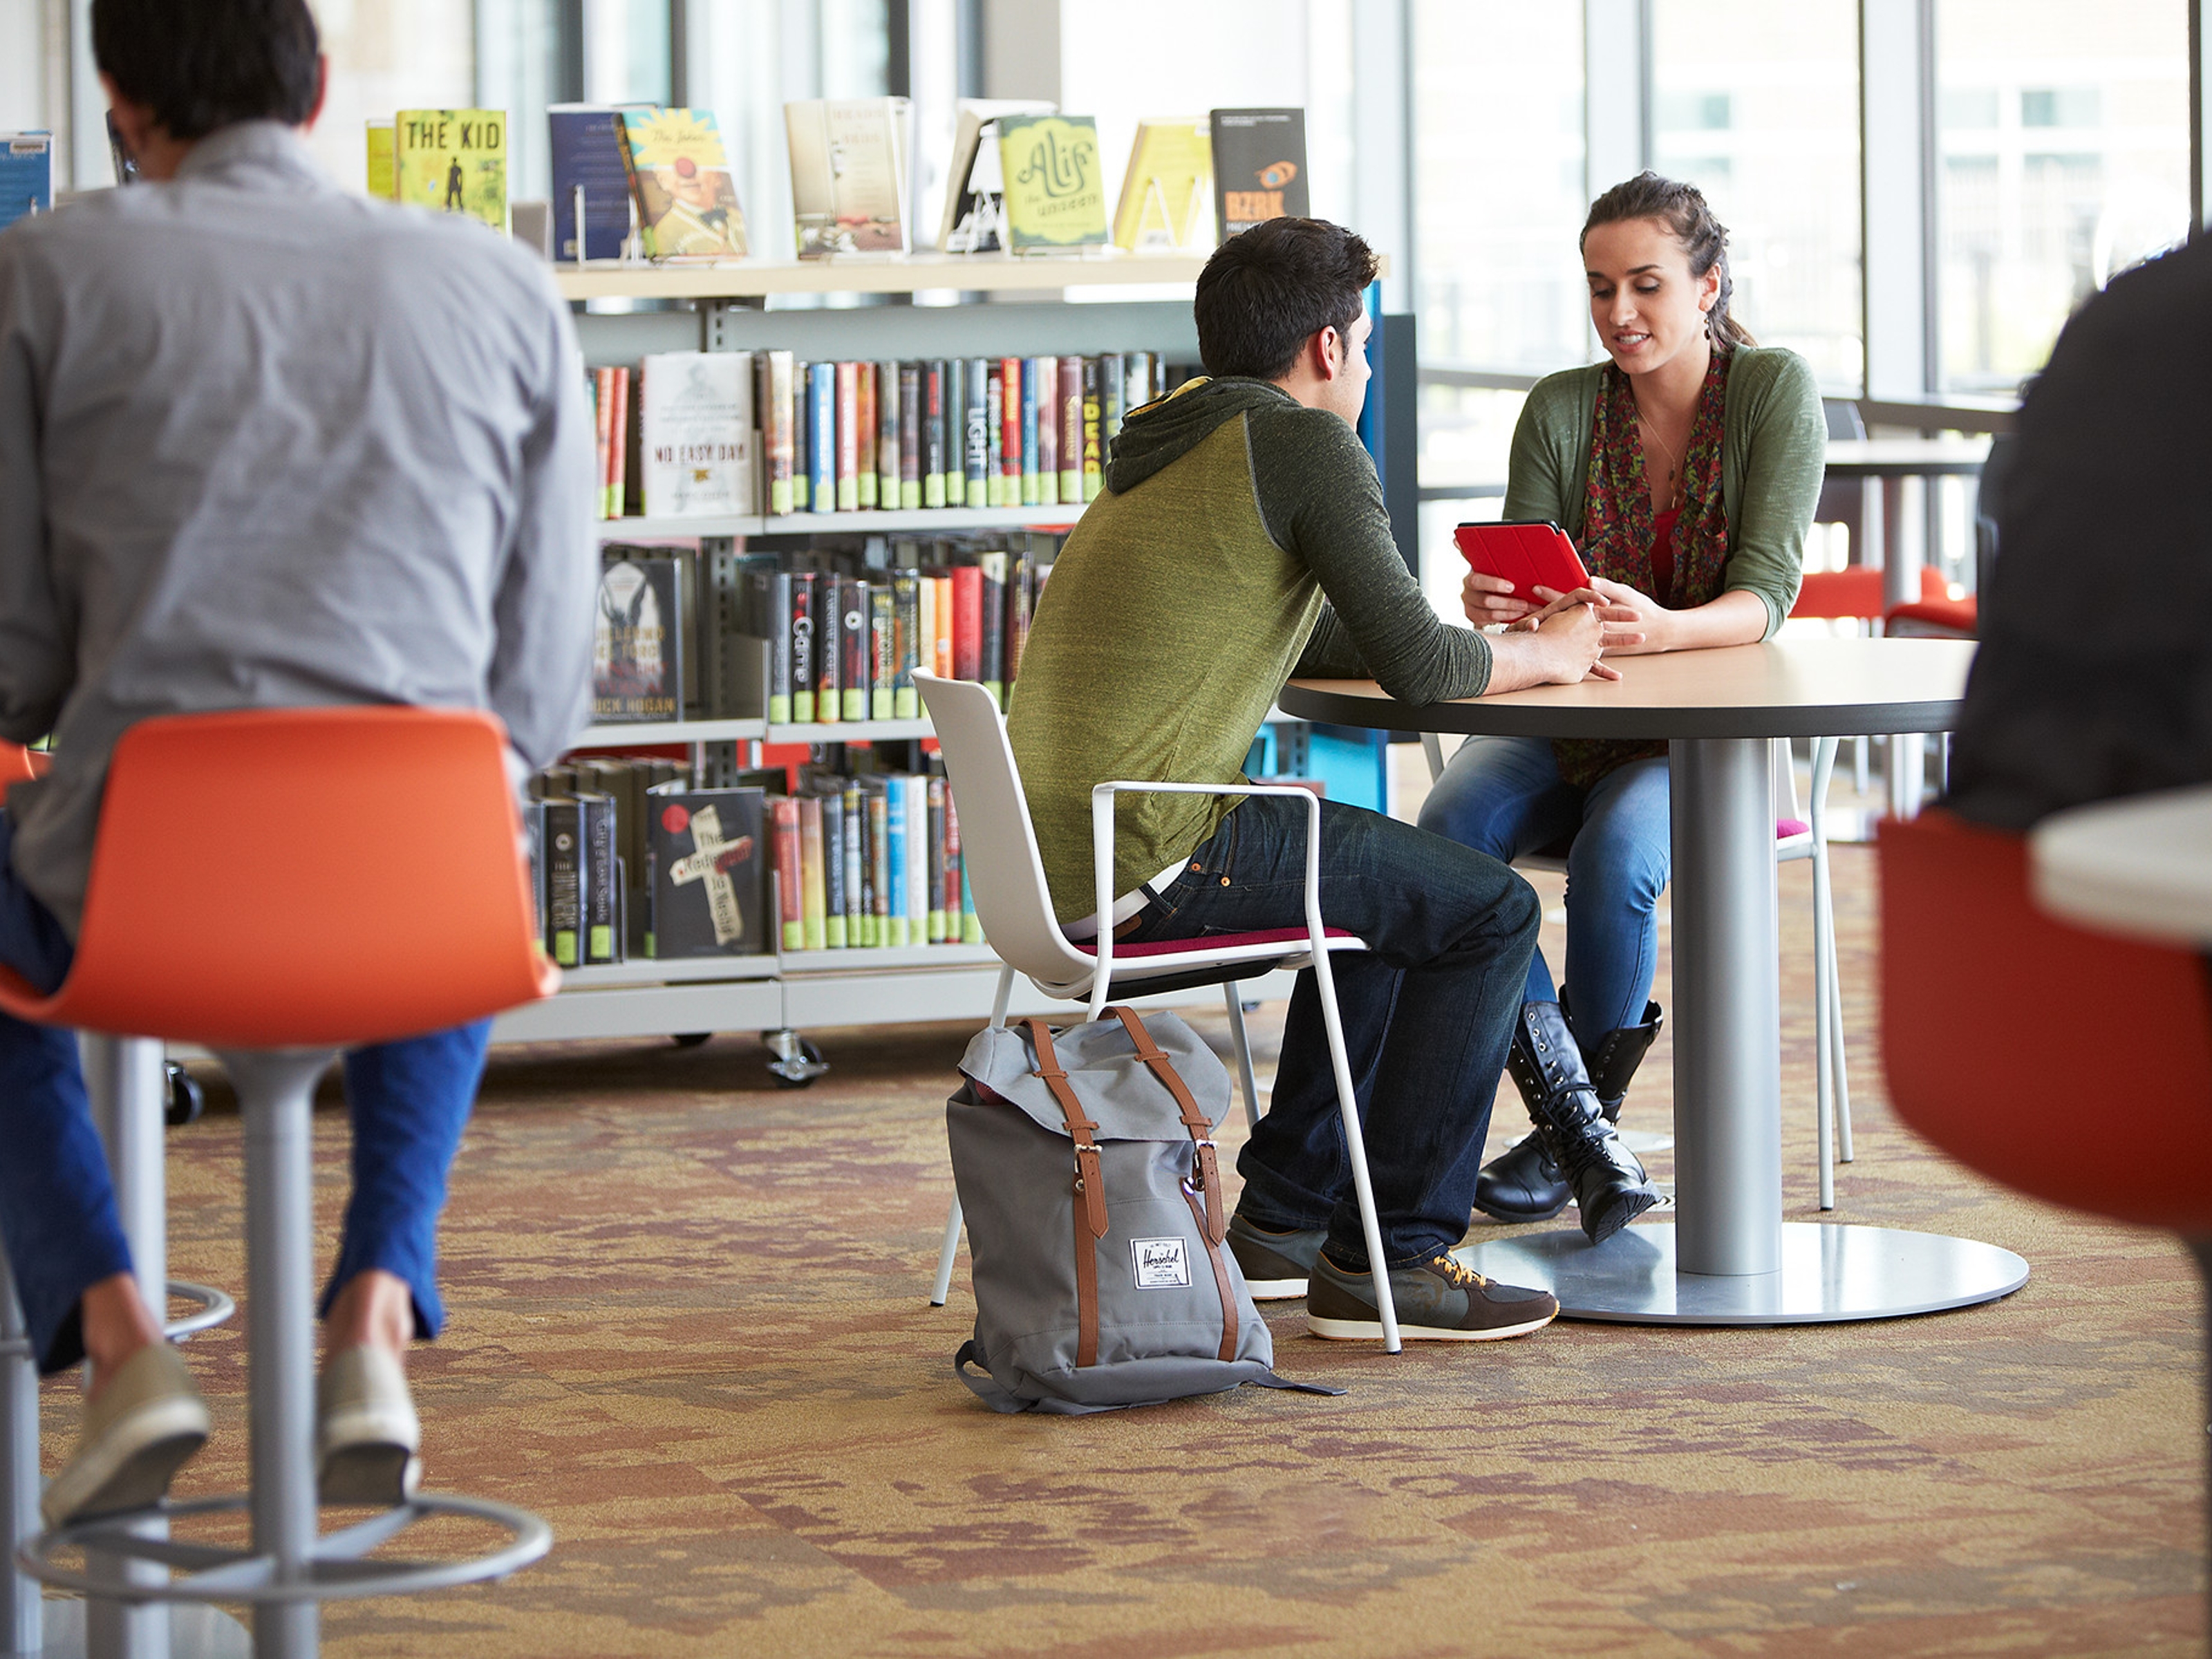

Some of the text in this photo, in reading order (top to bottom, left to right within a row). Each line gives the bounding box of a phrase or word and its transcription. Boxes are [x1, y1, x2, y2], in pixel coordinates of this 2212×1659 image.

[406, 121, 500, 149] THE KID
[1017, 129, 1094, 198] Alif
[968, 406, 988, 468] LIGHT
[655, 443, 745, 462] NO EASY DAY
[793, 616, 814, 683] Game
[626, 697, 676, 714] HOGAN
[697, 832, 725, 847] The
[1143, 1248, 1179, 1268] Herschel
